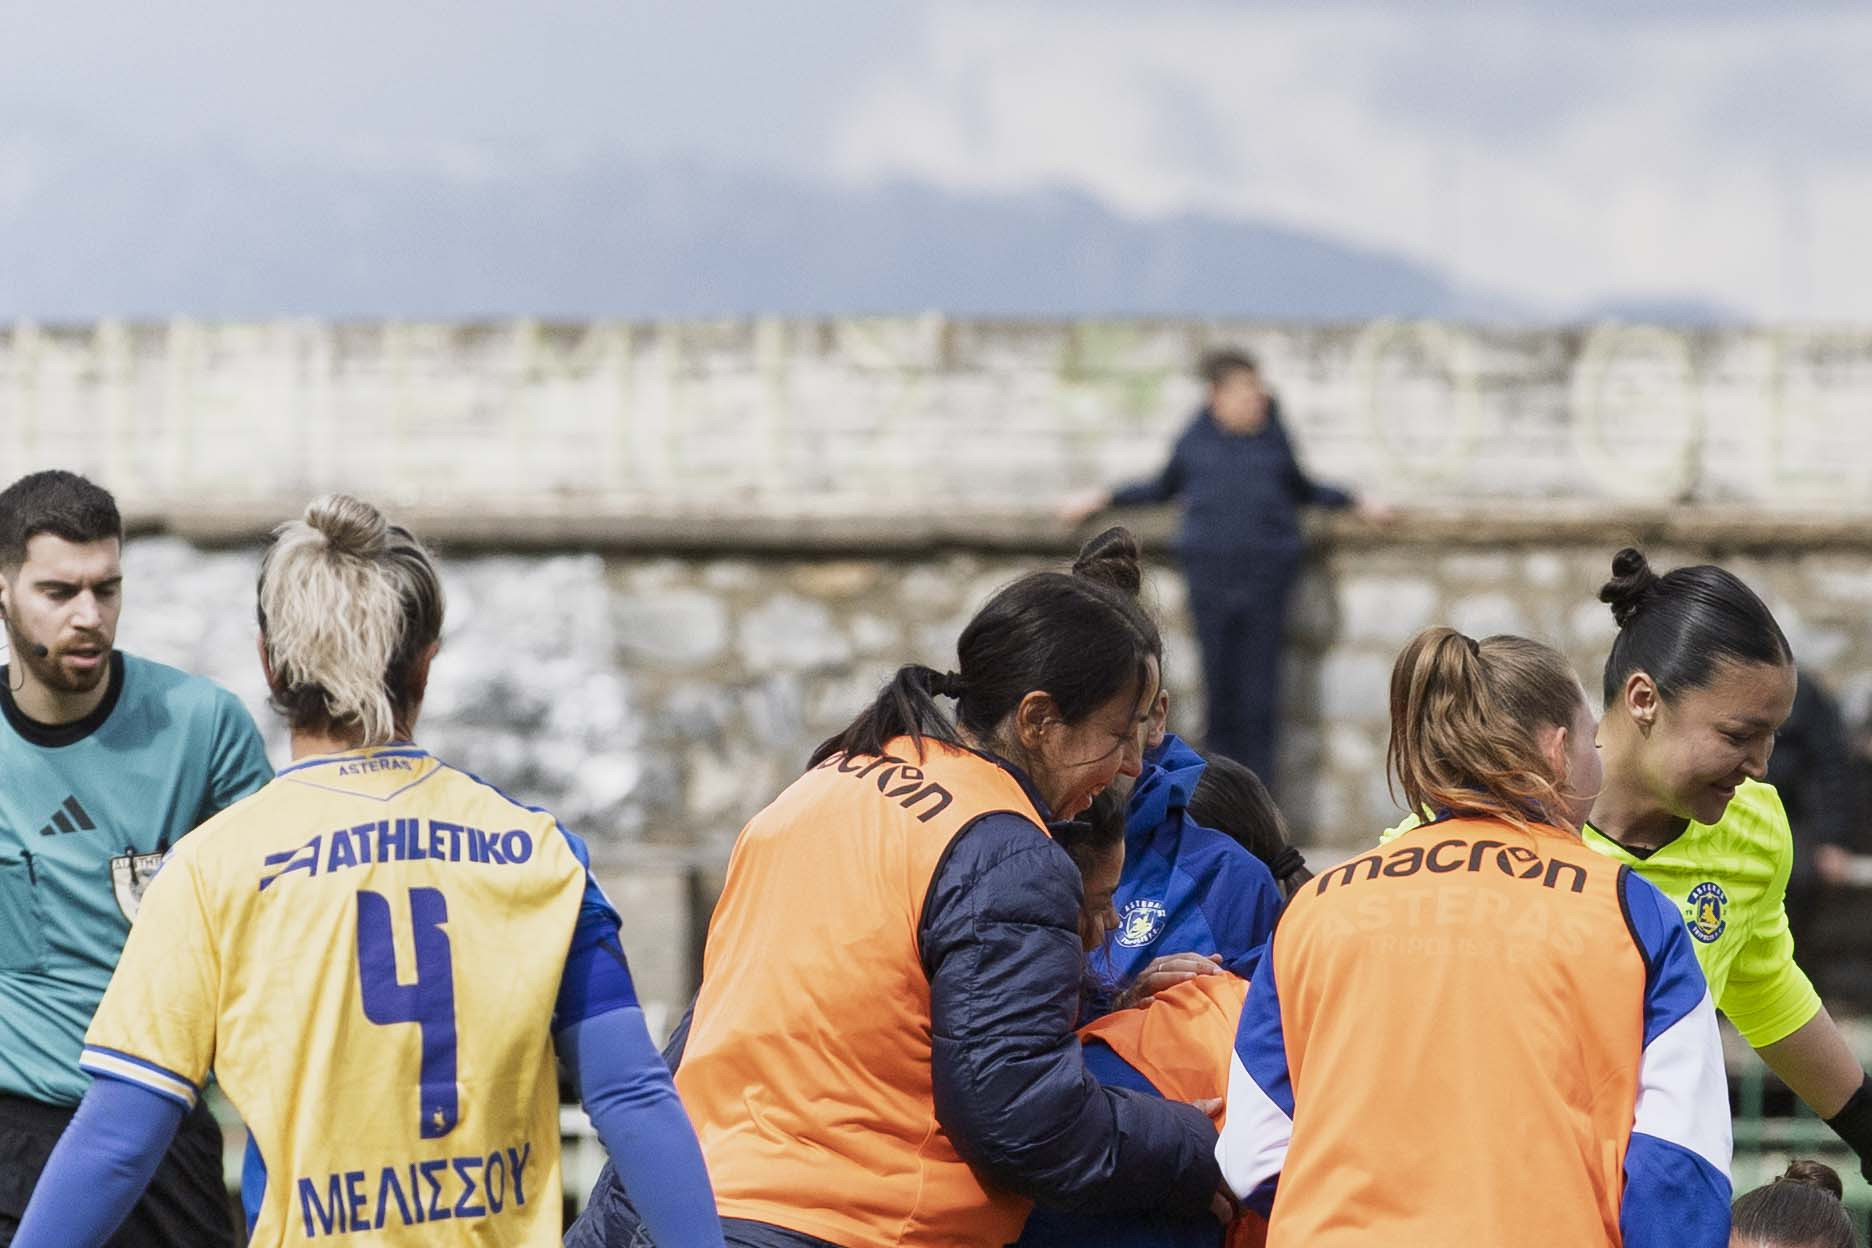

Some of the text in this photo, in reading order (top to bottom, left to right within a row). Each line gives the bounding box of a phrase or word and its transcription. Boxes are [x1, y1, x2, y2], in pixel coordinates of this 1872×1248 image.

[339, 758, 412, 777] ASTERAS
[816, 747, 954, 823] acron
[327, 818, 533, 873] ATHLETIKO
[1316, 839, 1588, 897] macron
[356, 886, 459, 1140] 4
[297, 1141, 531, 1239] ΜΕΛΙΣΣΟΥ
